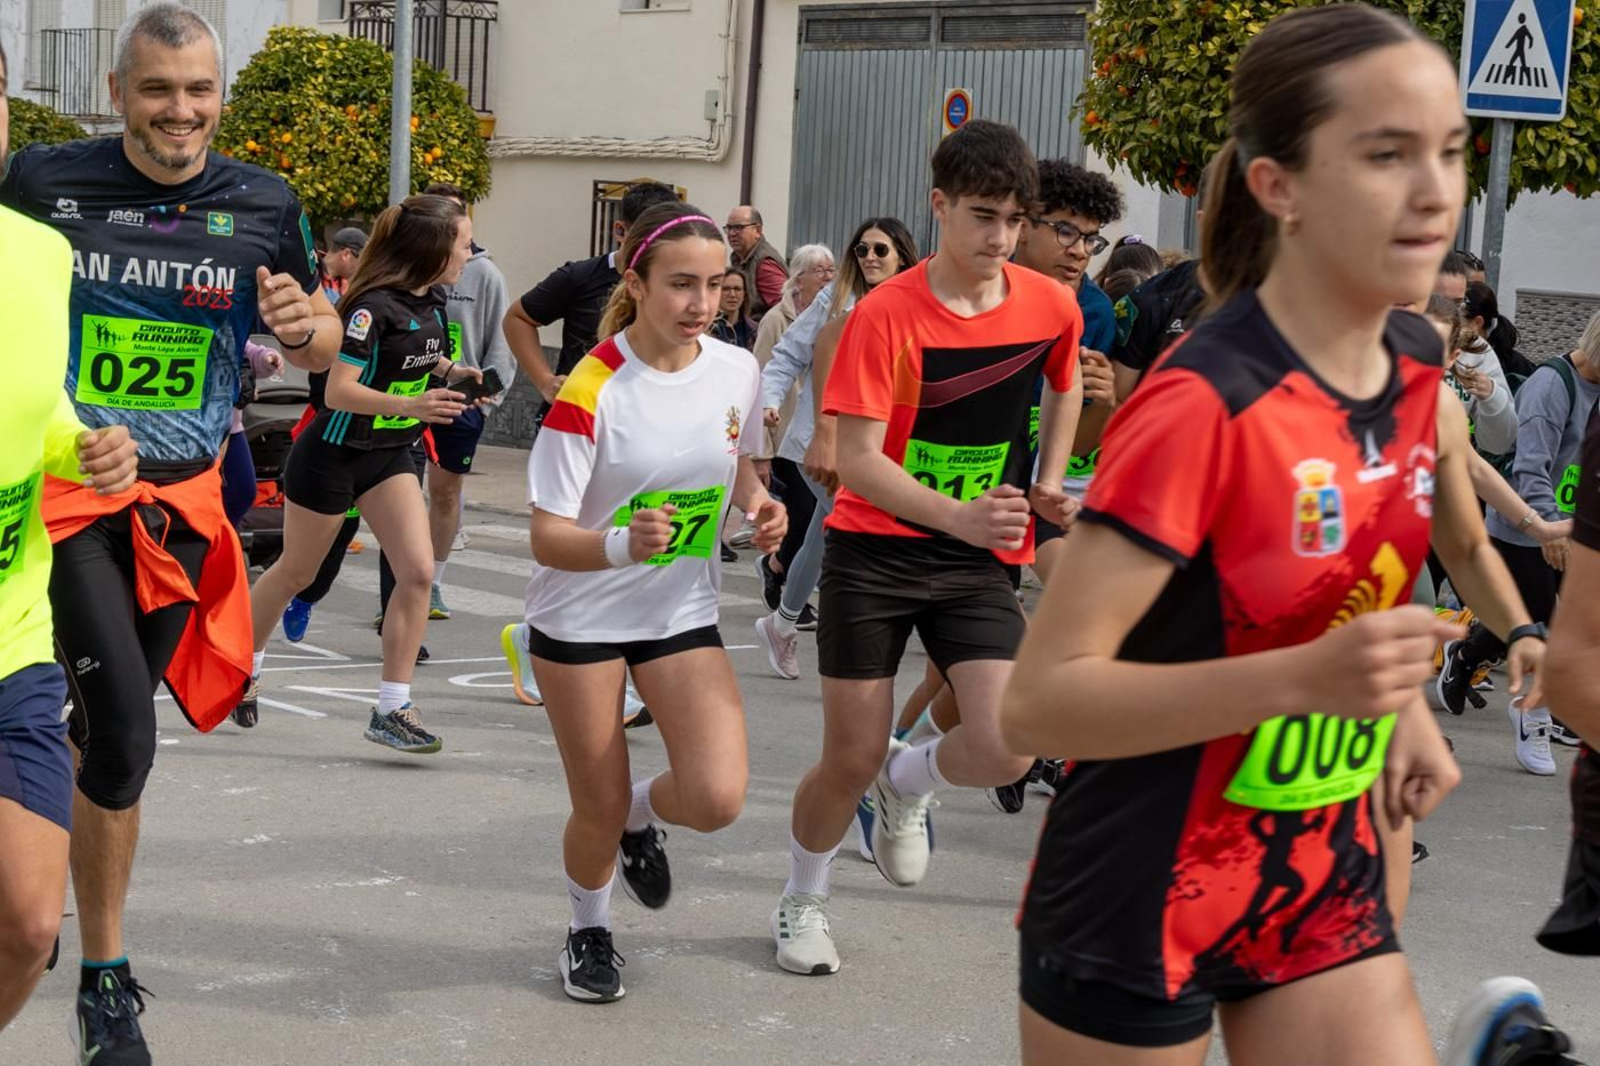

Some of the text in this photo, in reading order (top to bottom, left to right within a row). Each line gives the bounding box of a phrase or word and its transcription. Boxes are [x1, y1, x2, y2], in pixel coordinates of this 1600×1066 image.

[73, 249, 236, 295] AN ANTÓN
[182, 286, 234, 309] 2025
[132, 332, 206, 345] RUNNING
[139, 324, 201, 335] CIRCUITO
[134, 344, 156, 352] Monte
[426, 338, 440, 351] Fly
[402, 351, 440, 370] Emira
[90, 352, 196, 397] 025
[947, 453, 1003, 464] RUNNING
[664, 513, 711, 555] 27
[1266, 714, 1376, 786] 008
